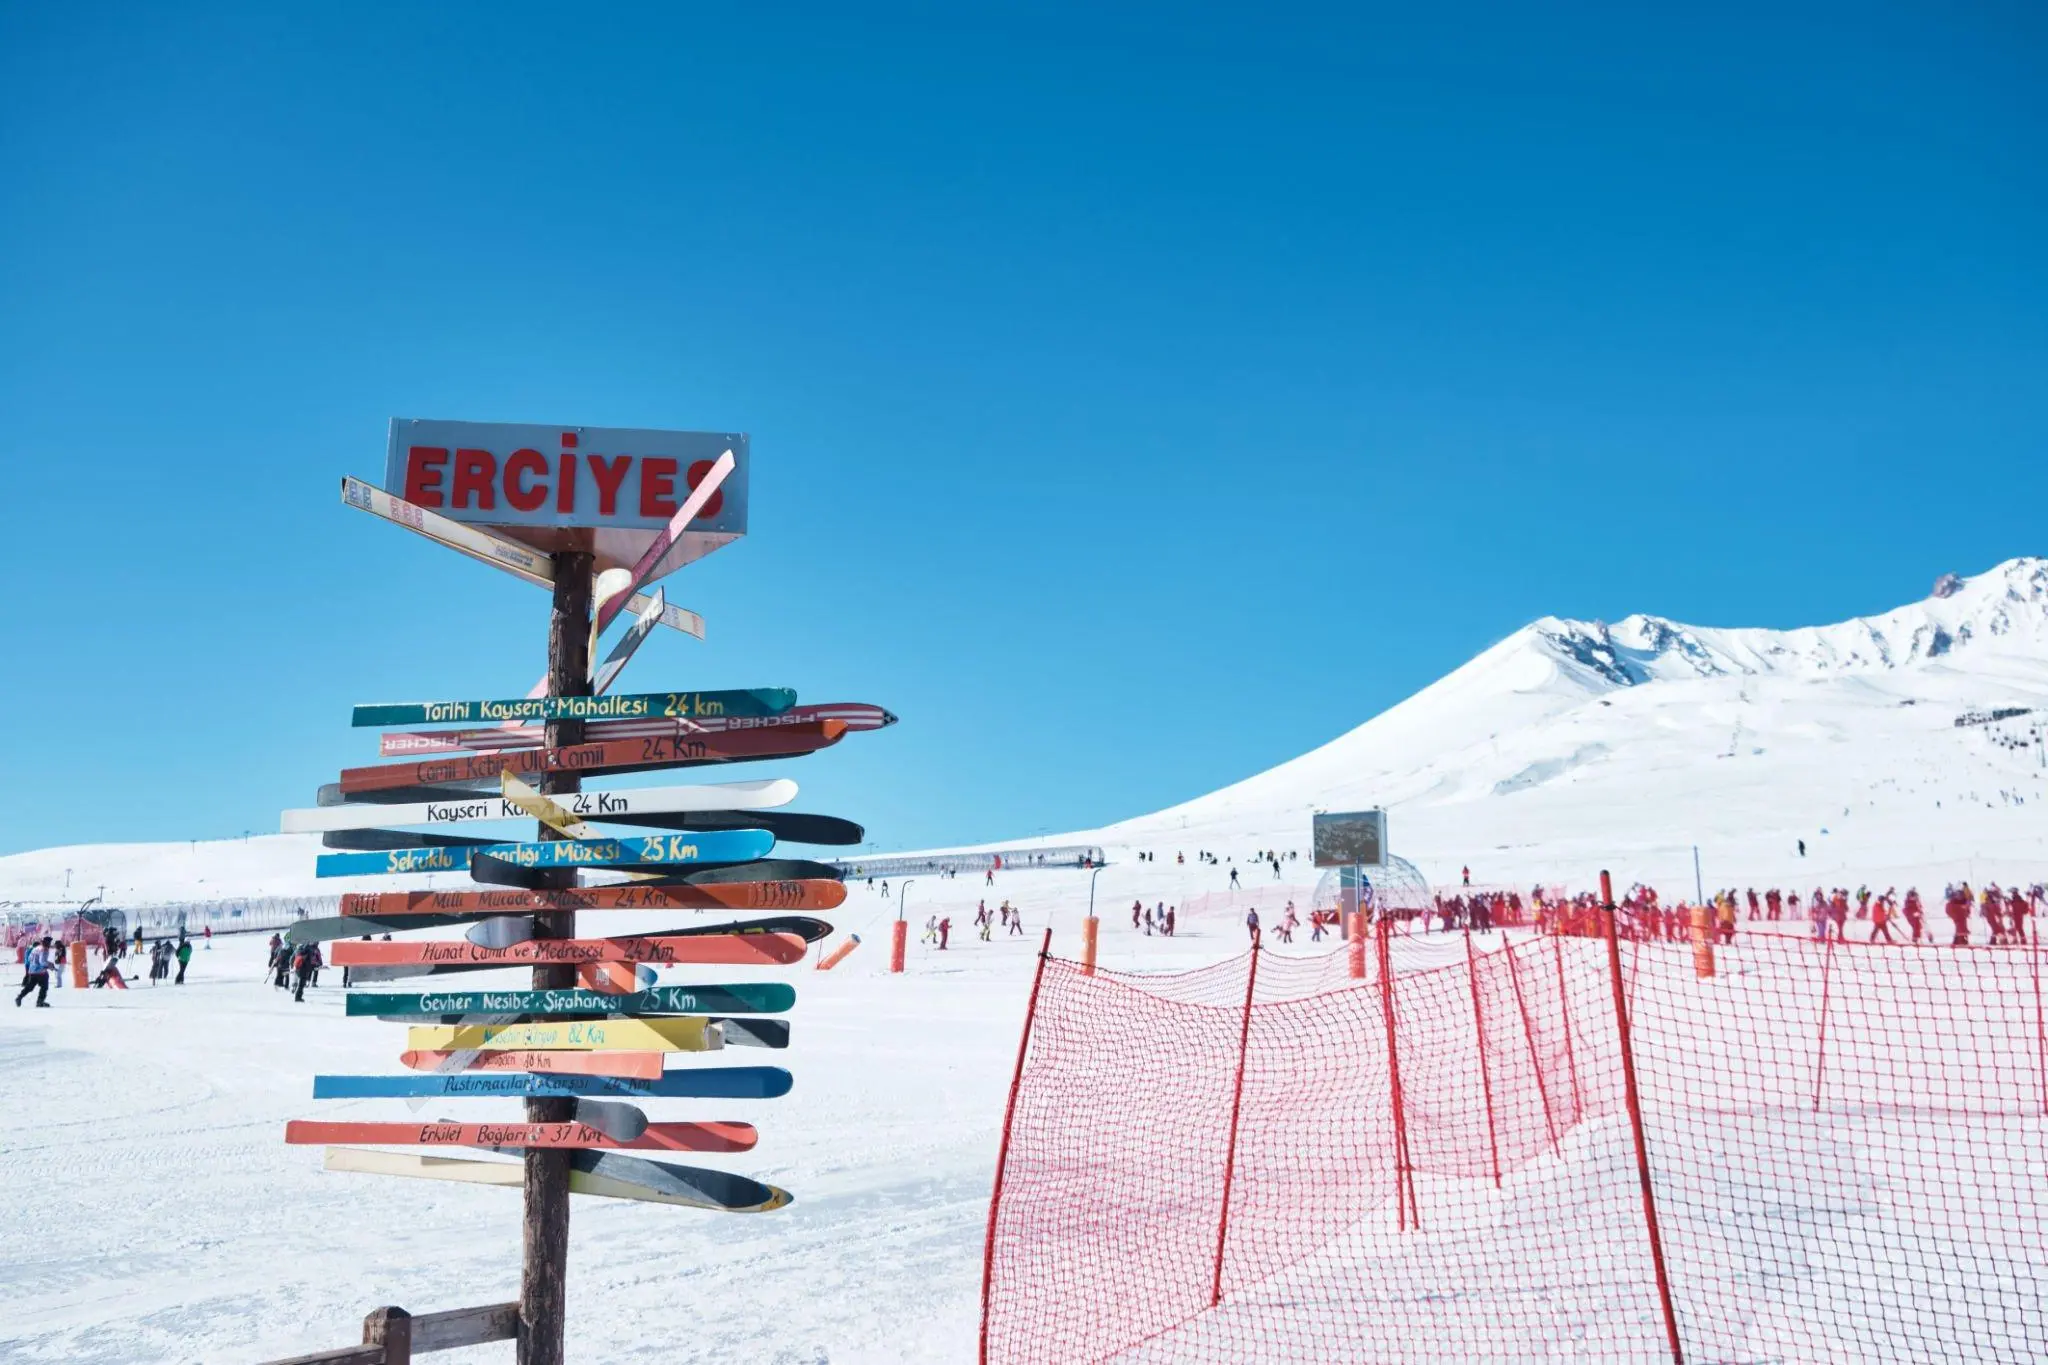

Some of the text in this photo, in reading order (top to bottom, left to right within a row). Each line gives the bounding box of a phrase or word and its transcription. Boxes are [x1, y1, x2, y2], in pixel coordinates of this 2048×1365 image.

[403, 432, 724, 518] ERCİYES
[423, 693, 723, 721] Tarihi Kayseri Mahallesi 24 km
[729, 713, 815, 729] FISCHER
[384, 736, 458, 750] FISCHER
[642, 738, 665, 760] 24
[673, 735, 705, 758] Km
[428, 801, 487, 822] Kayseri
[573, 793, 591, 813] 24
[599, 792, 628, 812] Km
[640, 837, 664, 862] 25
[669, 836, 698, 860] Km
[615, 889, 636, 907] 24
[643, 888, 669, 906] Km
[421, 942, 465, 960] Hunat
[514, 947, 528, 957] ve
[624, 939, 643, 959] 24
[649, 939, 674, 960] Km
[420, 993, 472, 1012] Gevher
[483, 992, 530, 1010] Nesibe
[669, 988, 696, 1010] Km
[420, 1125, 462, 1143] Erkilet
[550, 1126, 573, 1143] 37
[577, 1125, 602, 1143] Km
